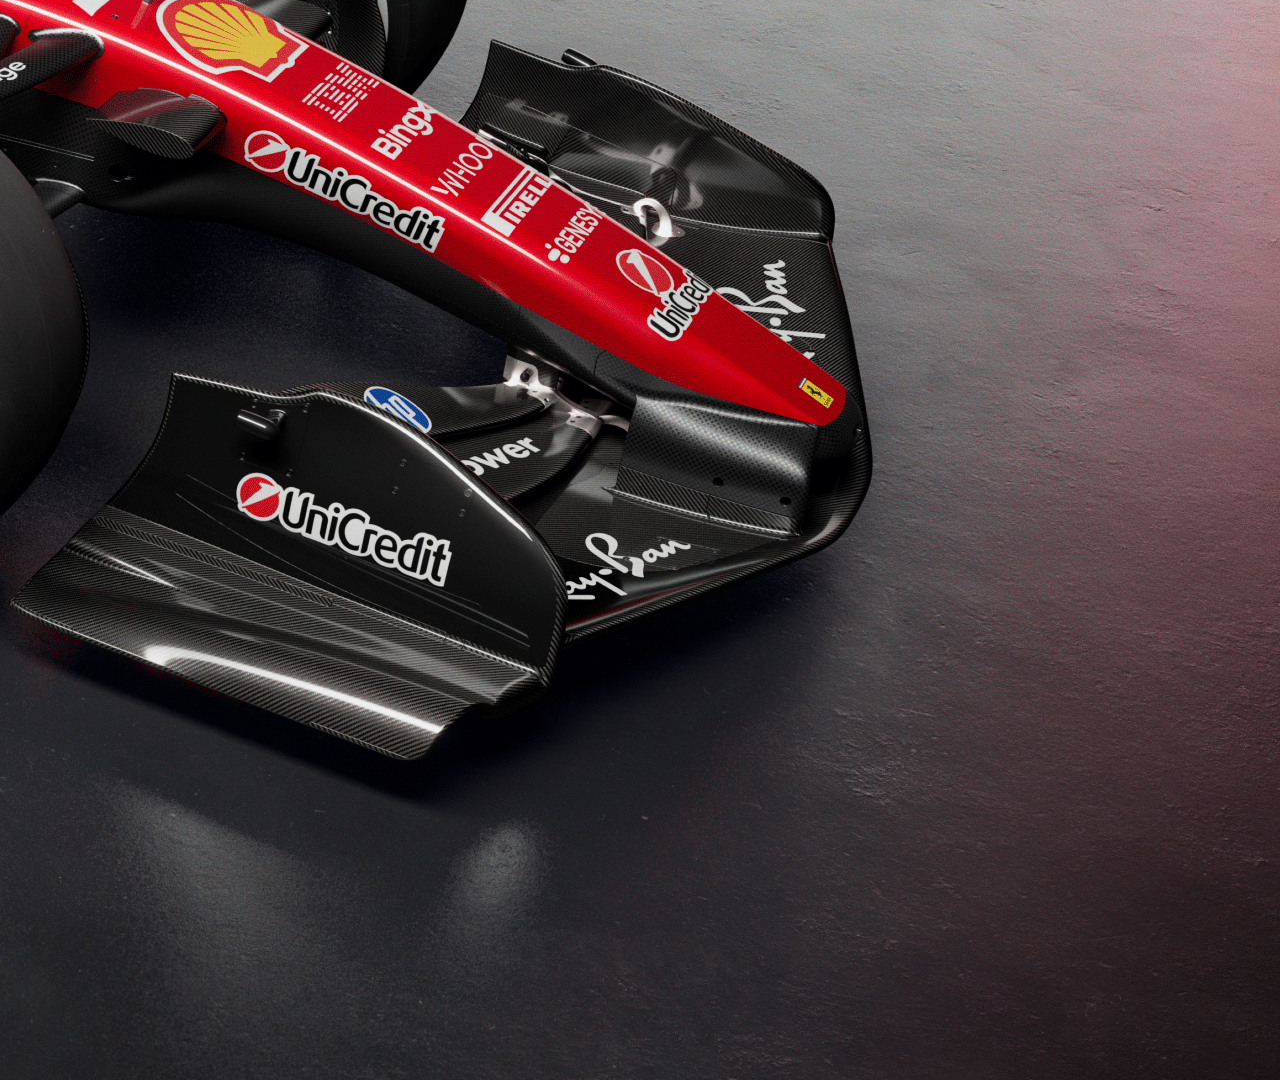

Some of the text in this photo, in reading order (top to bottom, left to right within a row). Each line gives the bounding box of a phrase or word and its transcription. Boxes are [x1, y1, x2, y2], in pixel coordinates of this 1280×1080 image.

[301, 61, 381, 123] IBM
[285, 148, 444, 254] UniCredit
[480, 164, 554, 238] PIRELL
[553, 200, 607, 255] GENESY
[364, 386, 433, 434] hp
[458, 437, 541, 477] ower
[282, 485, 450, 585] UniCredit
[565, 532, 692, 601] ay-Ban
